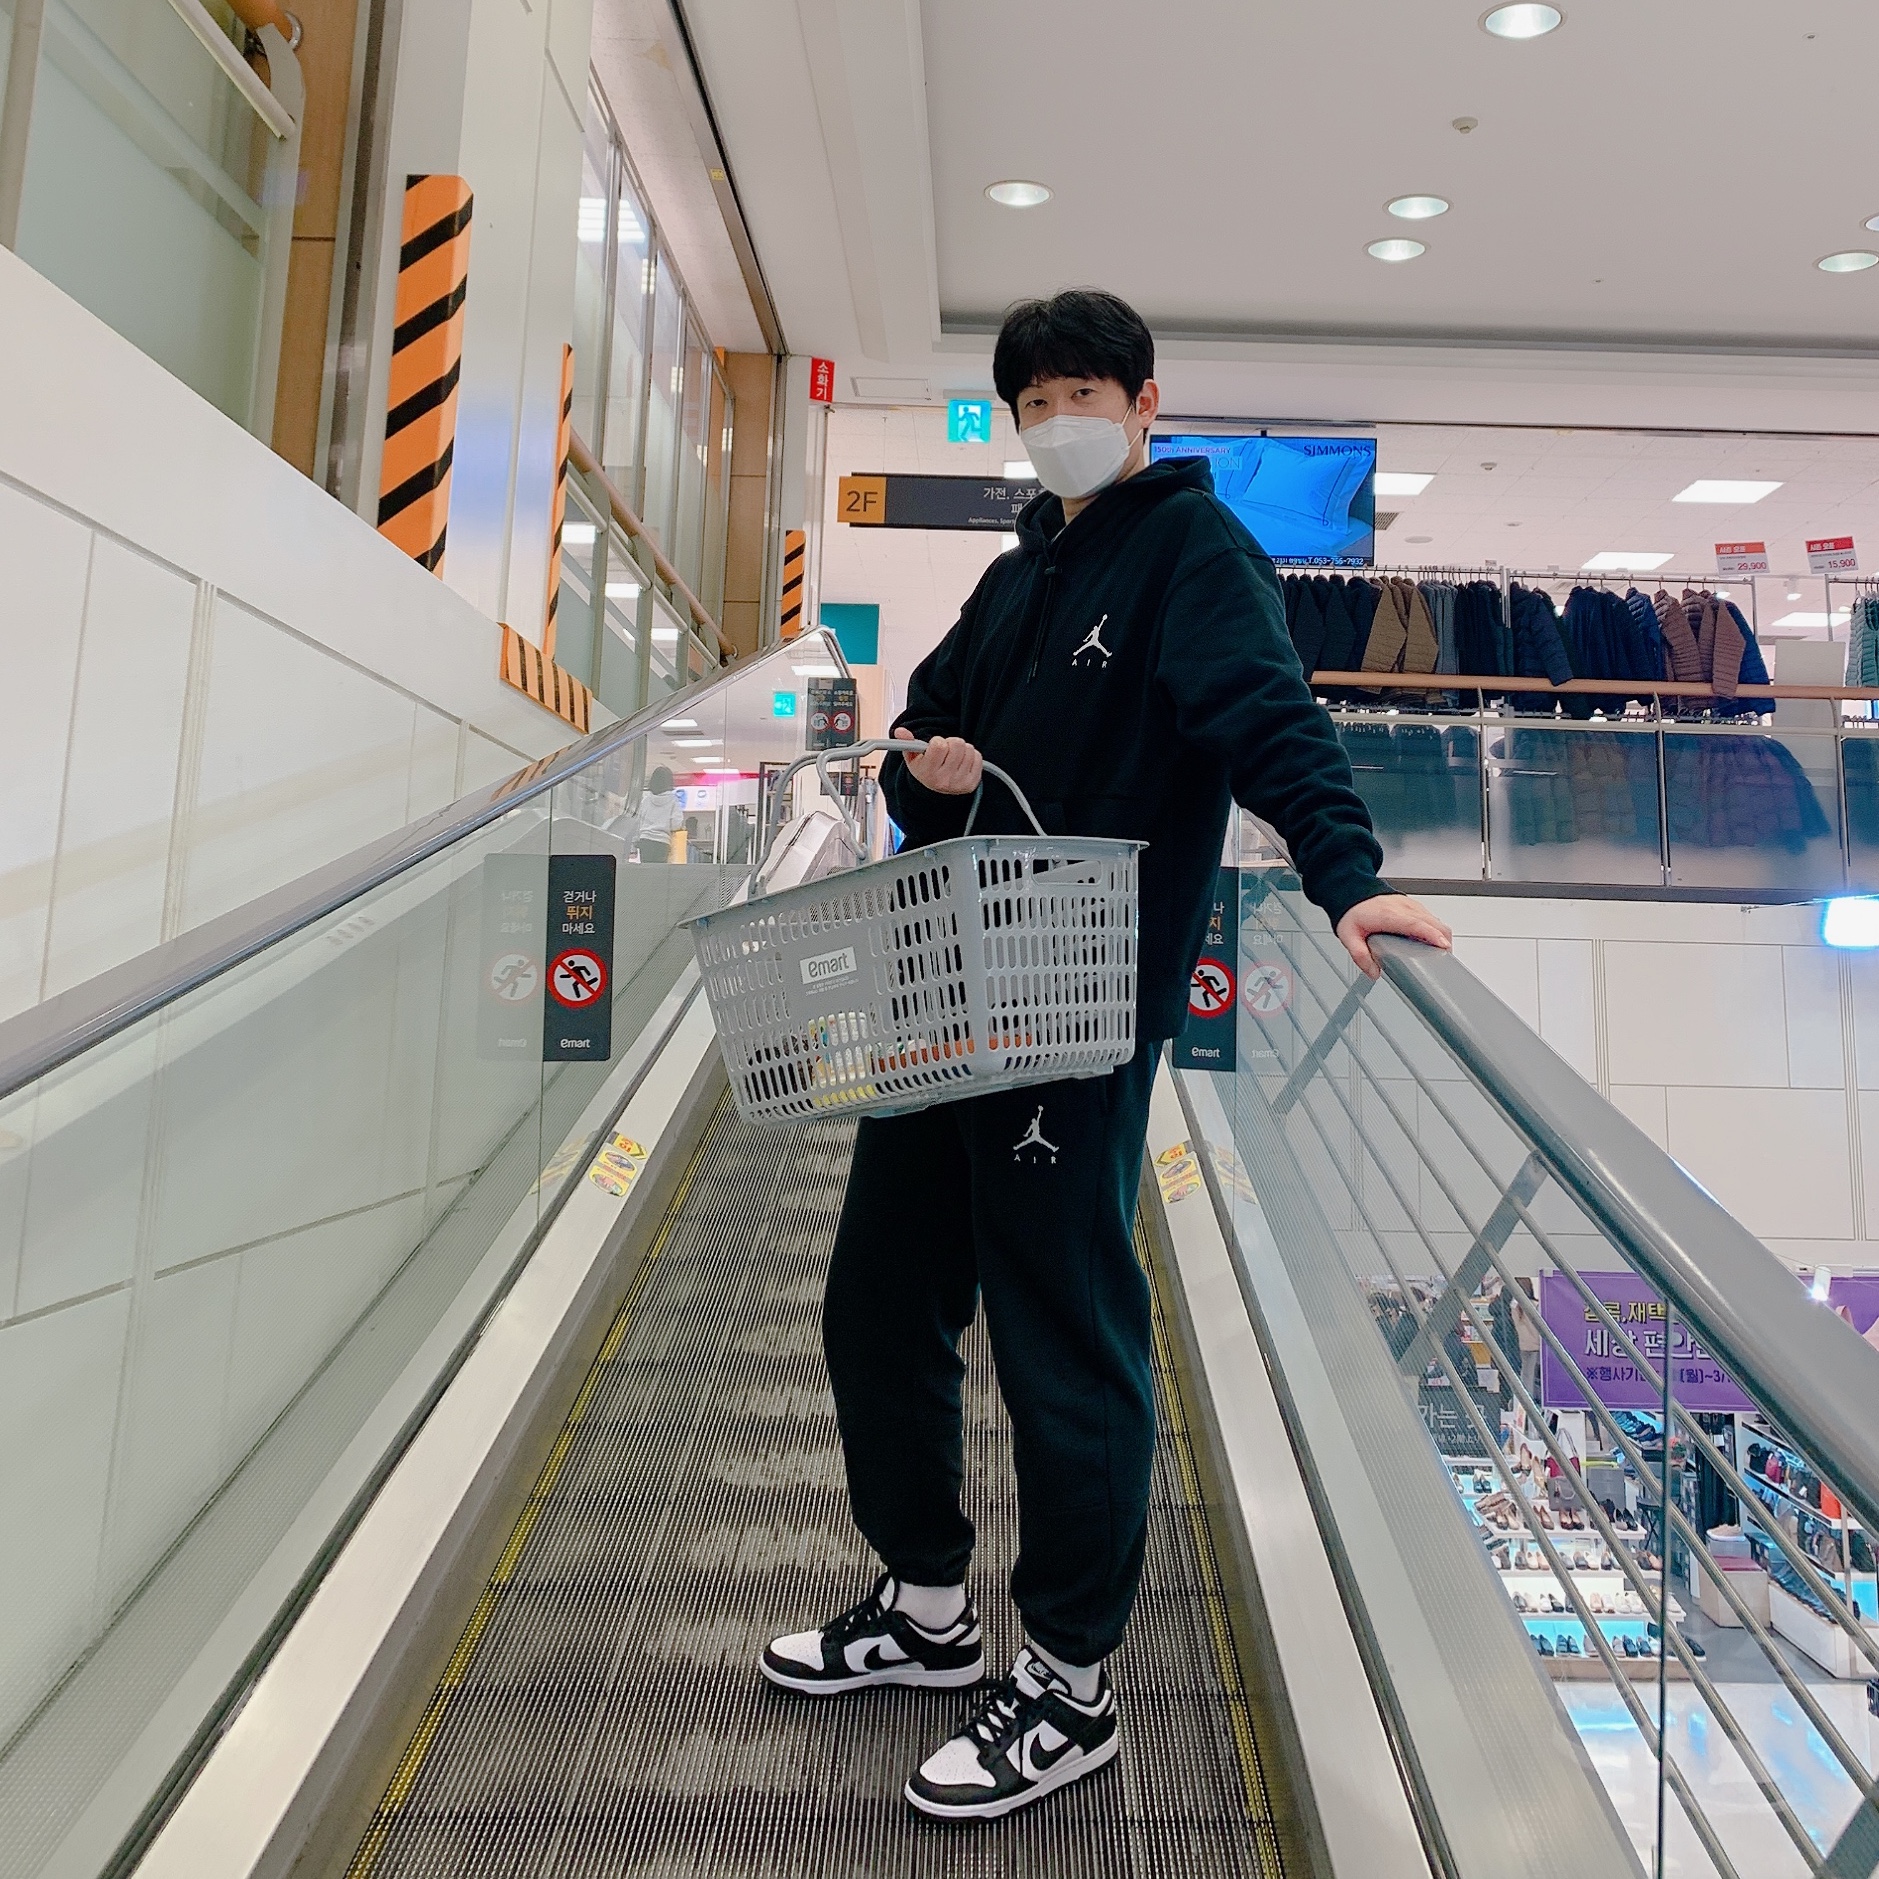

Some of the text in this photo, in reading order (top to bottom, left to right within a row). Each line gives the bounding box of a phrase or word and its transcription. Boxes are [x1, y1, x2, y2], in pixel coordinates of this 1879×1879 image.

[816, 361, 829, 401] 소화기
[1176, 446, 1231, 454] ANNIVERSARY
[846, 490, 878, 512] 2F
[1011, 503, 1022, 514] 패
[1737, 562, 1767, 571] 29,900
[1828, 558, 1856, 569] 15,900
[1072, 658, 1108, 669] AIR
[563, 890, 597, 903] 걷거나
[566, 905, 593, 920] 뛰지
[562, 922, 596, 935] 마세요
[1205, 932, 1224, 946] 세요
[808, 952, 850, 978] emart
[560, 1038, 591, 1048] emart
[1191, 1046, 1221, 1058] emart
[1014, 1154, 1057, 1164] AIR
